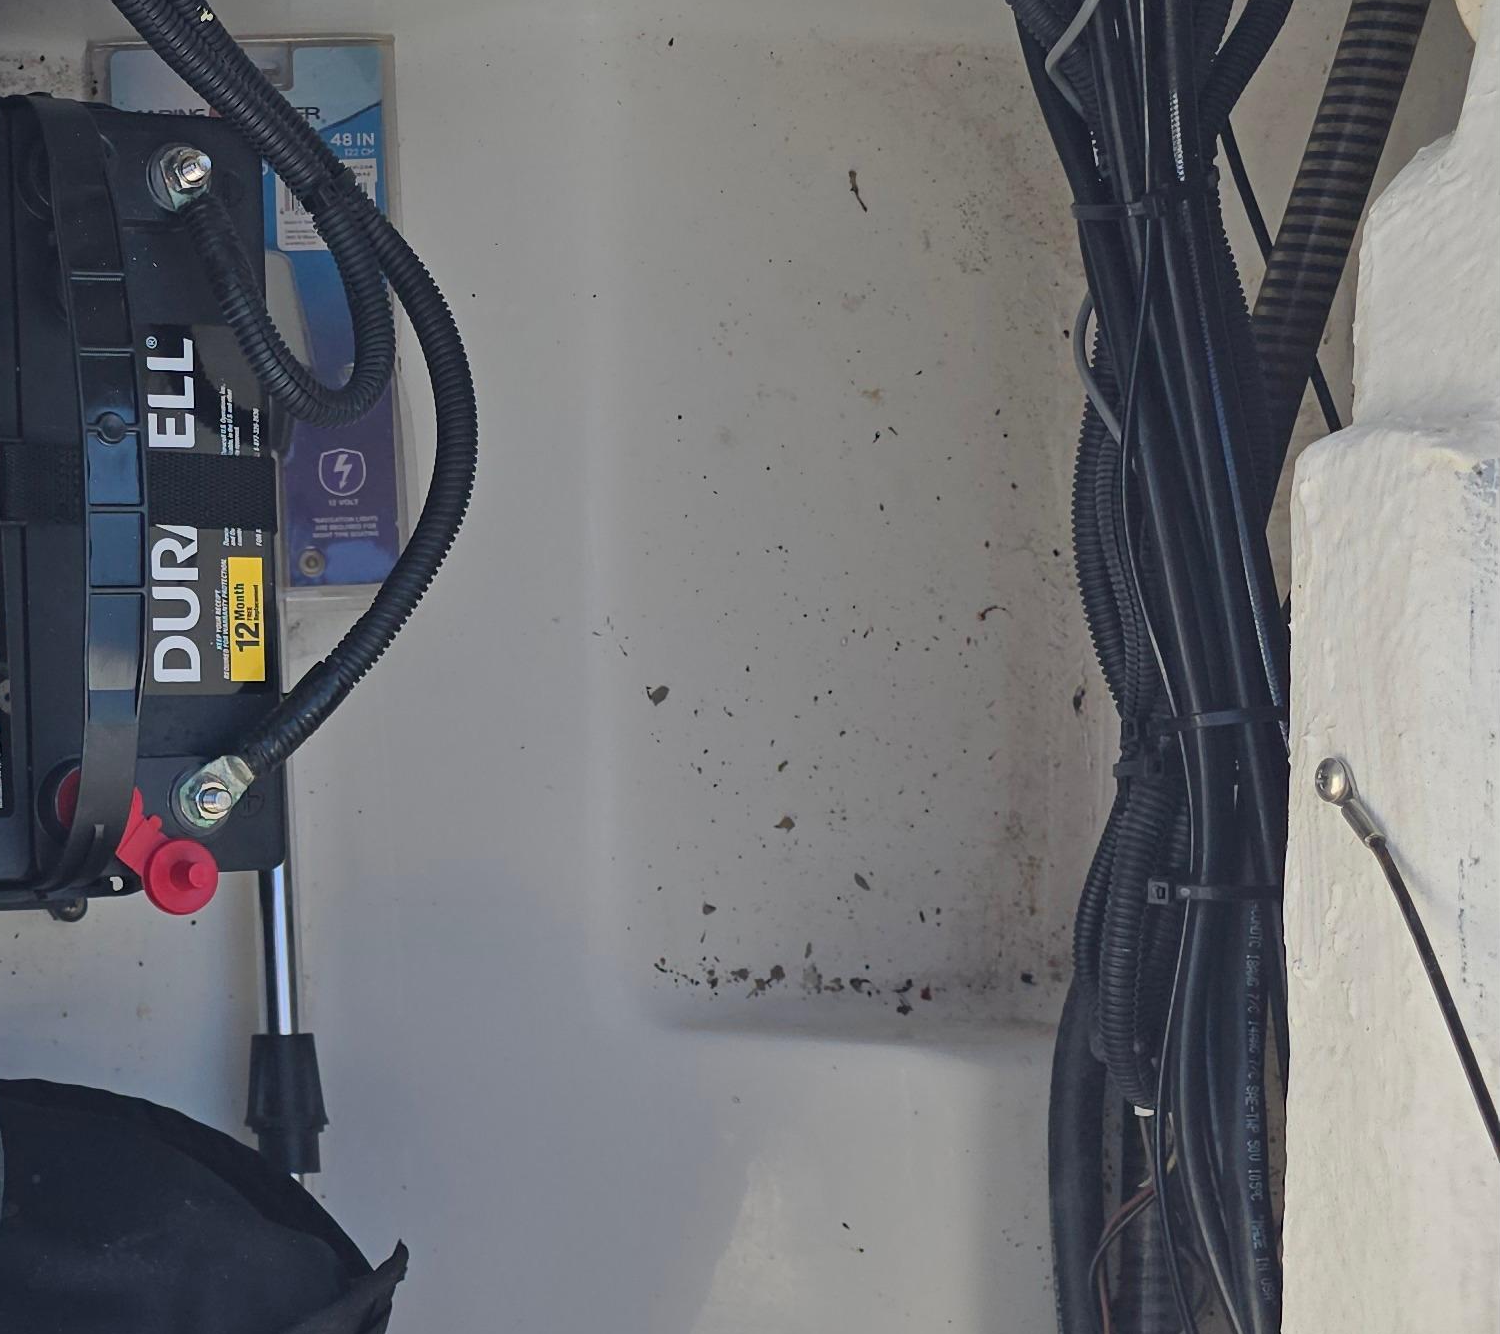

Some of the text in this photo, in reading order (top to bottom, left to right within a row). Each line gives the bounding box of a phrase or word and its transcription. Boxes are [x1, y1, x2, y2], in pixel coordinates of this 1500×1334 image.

[330, 132, 376, 147] 48 IN
[147, 338, 201, 683] DURELL
[221, 598, 229, 635] WARRANTY
[233, 583, 260, 653] 12 Month
